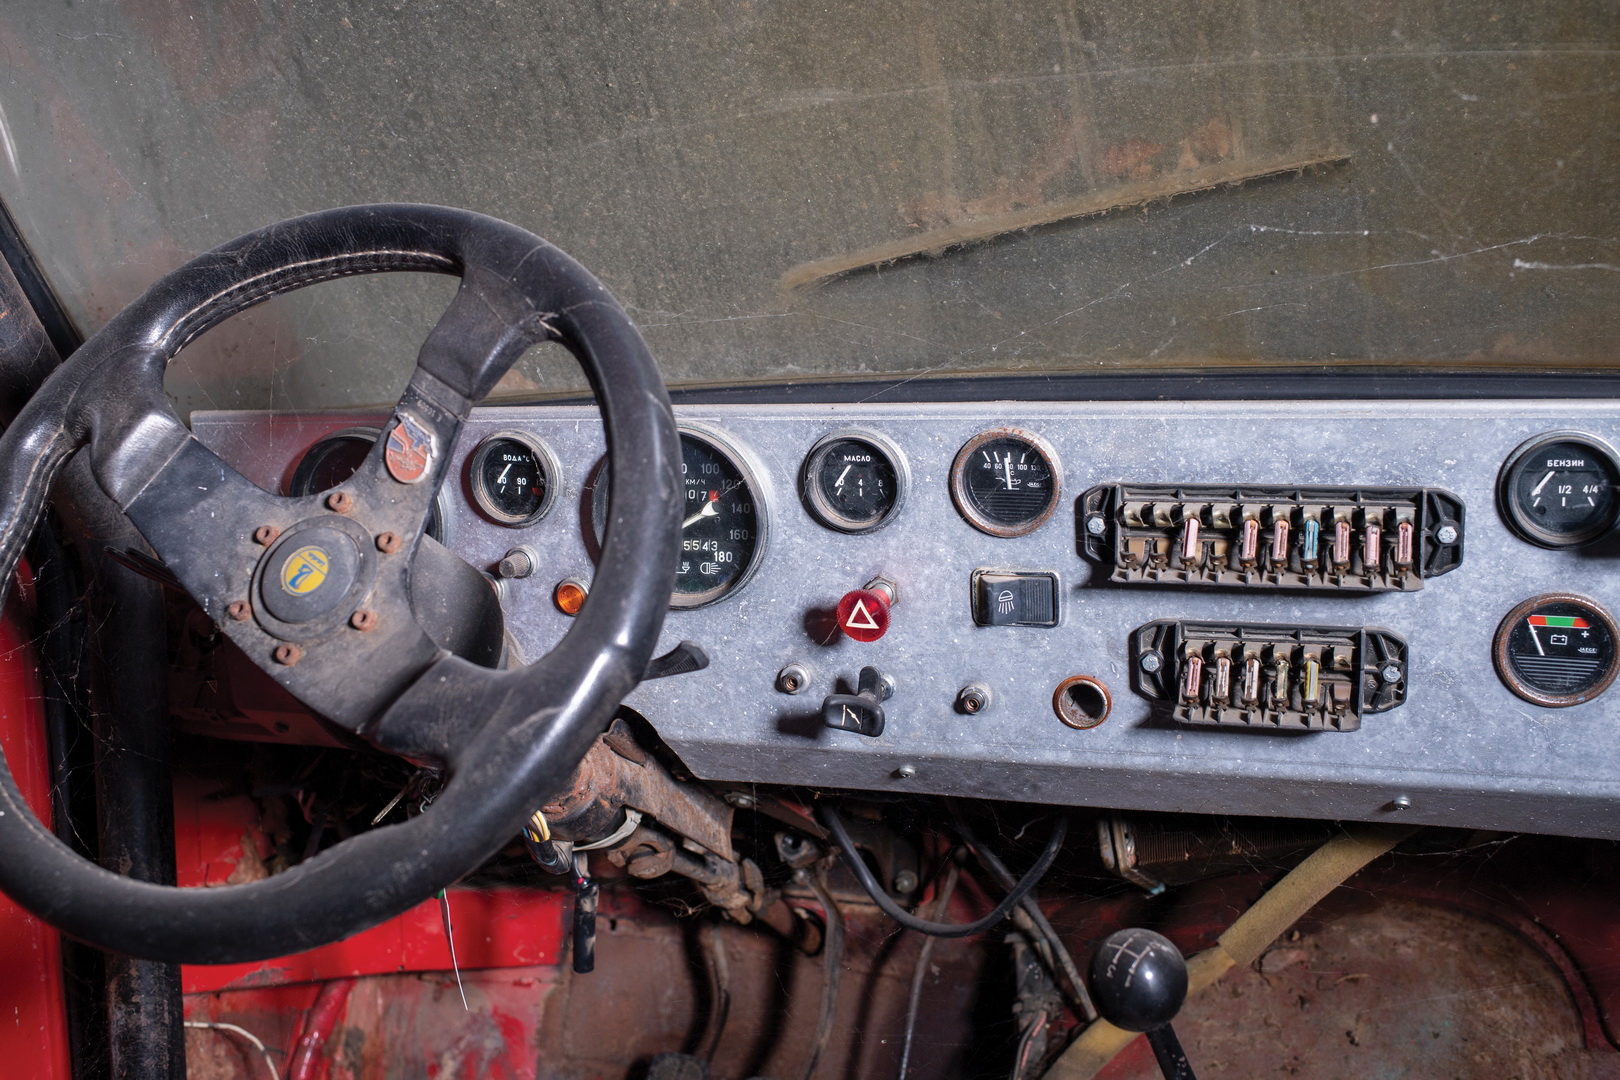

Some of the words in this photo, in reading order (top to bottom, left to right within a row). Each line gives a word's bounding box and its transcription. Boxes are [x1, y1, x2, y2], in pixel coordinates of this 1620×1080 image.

[702, 463, 720, 474] 100
[516, 478, 526, 486] 90
[858, 478, 862, 486] 4
[1558, 485, 1572, 494] 1/2
[1582, 485, 1598, 494] 4/4
[732, 502, 750, 514] 140
[730, 530, 748, 540] 160
[714, 551, 732, 562] 180
